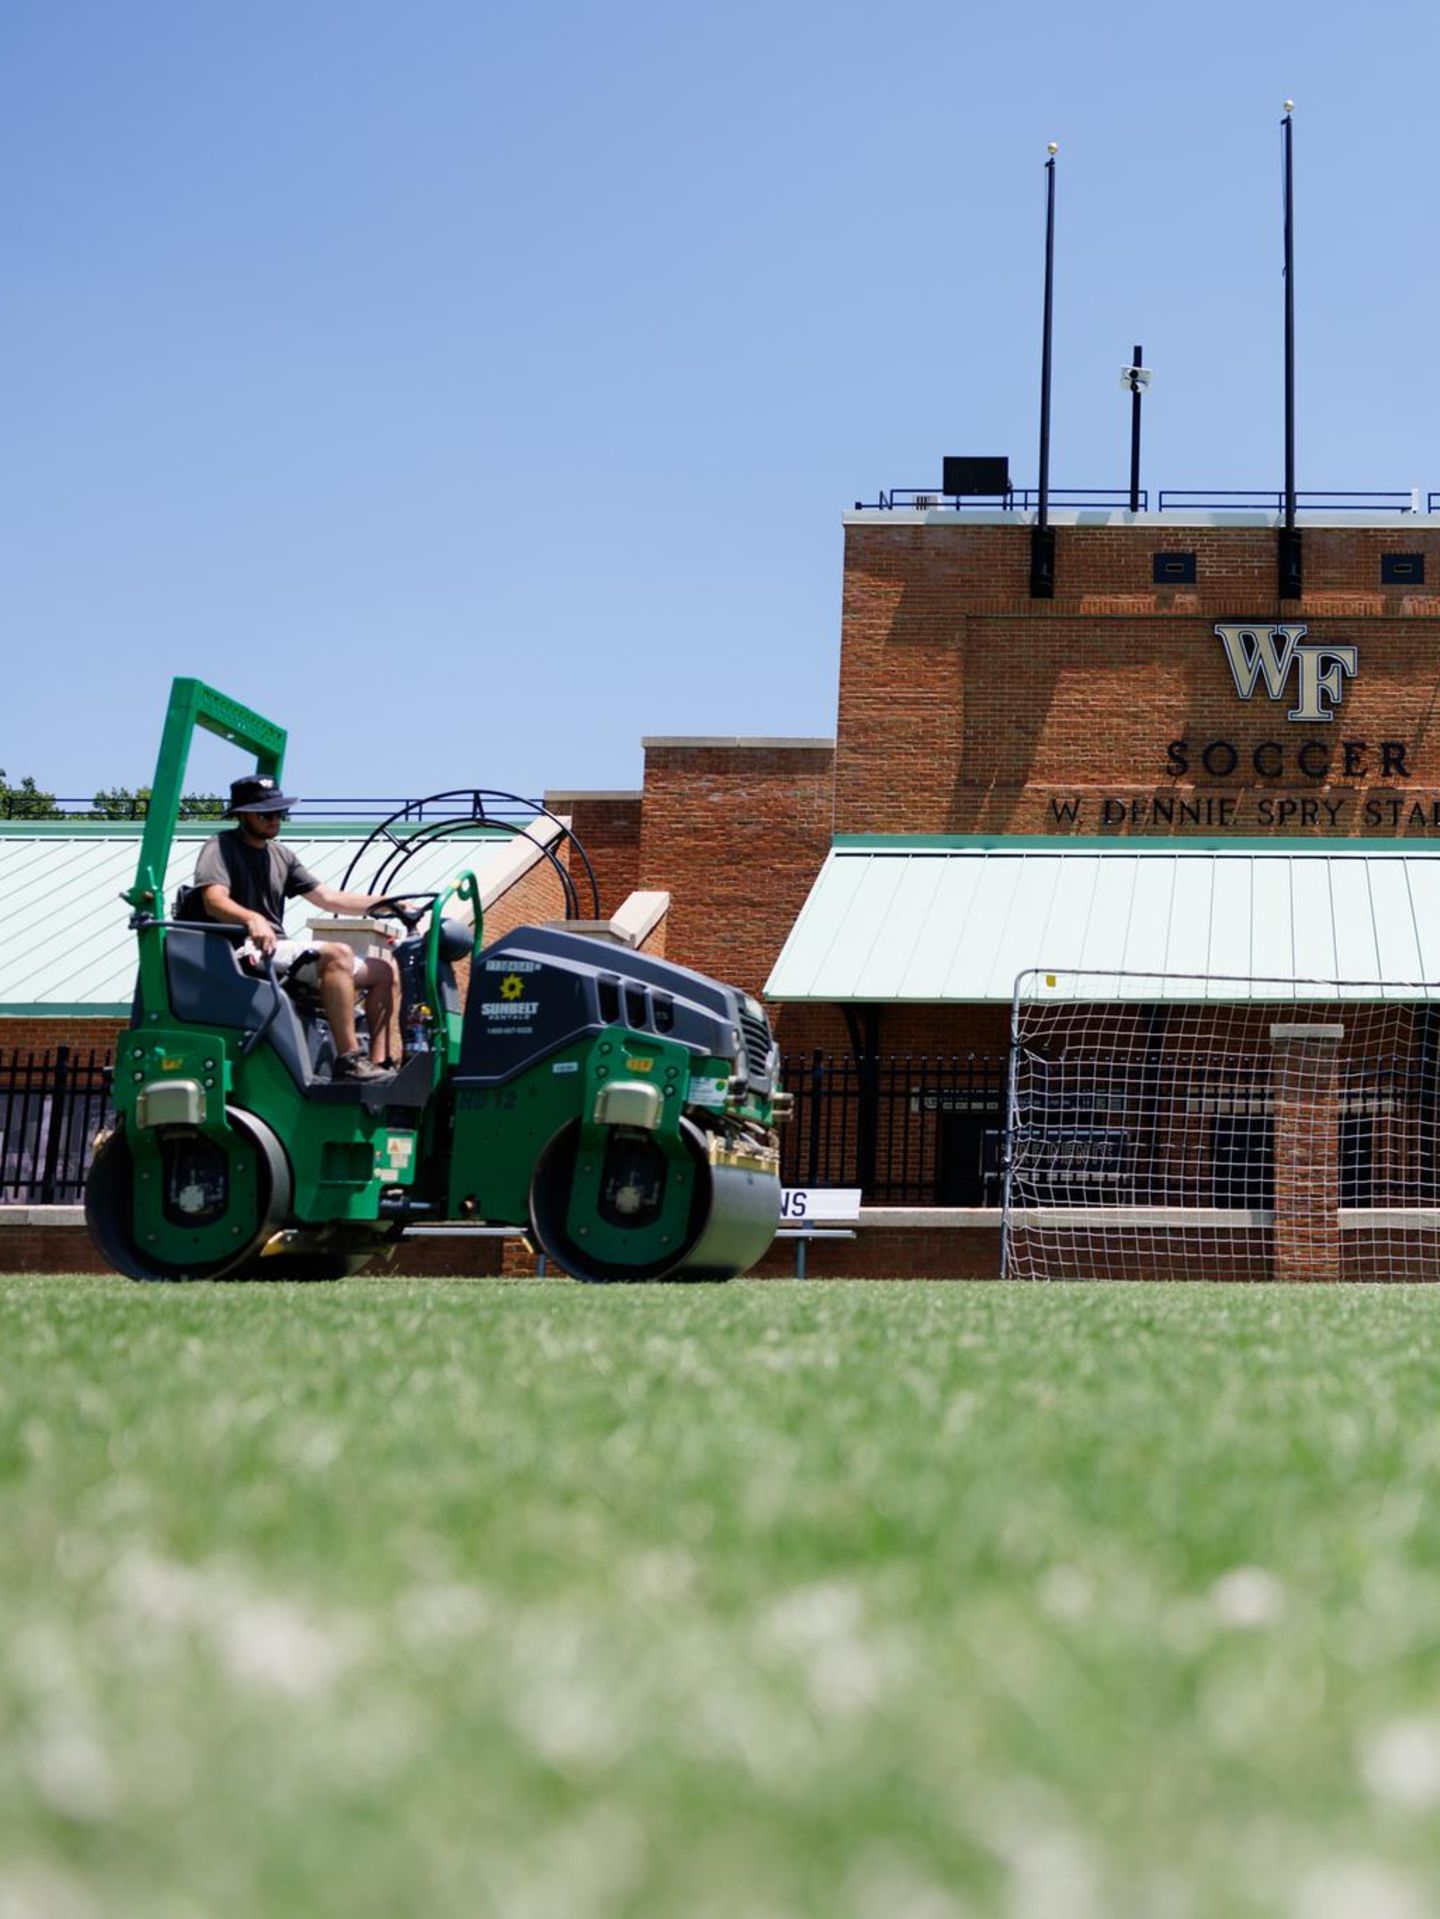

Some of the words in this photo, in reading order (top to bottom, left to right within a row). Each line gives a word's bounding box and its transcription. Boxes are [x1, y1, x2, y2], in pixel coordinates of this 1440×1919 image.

[1214, 623, 1358, 722] WF
[1165, 741, 1412, 778] SOCCER
[1052, 798, 1085, 825] W.
[1102, 797, 1237, 826] DENNIE
[1257, 798, 1346, 827] SPRY
[481, 1002, 539, 1016] SUNBELT
